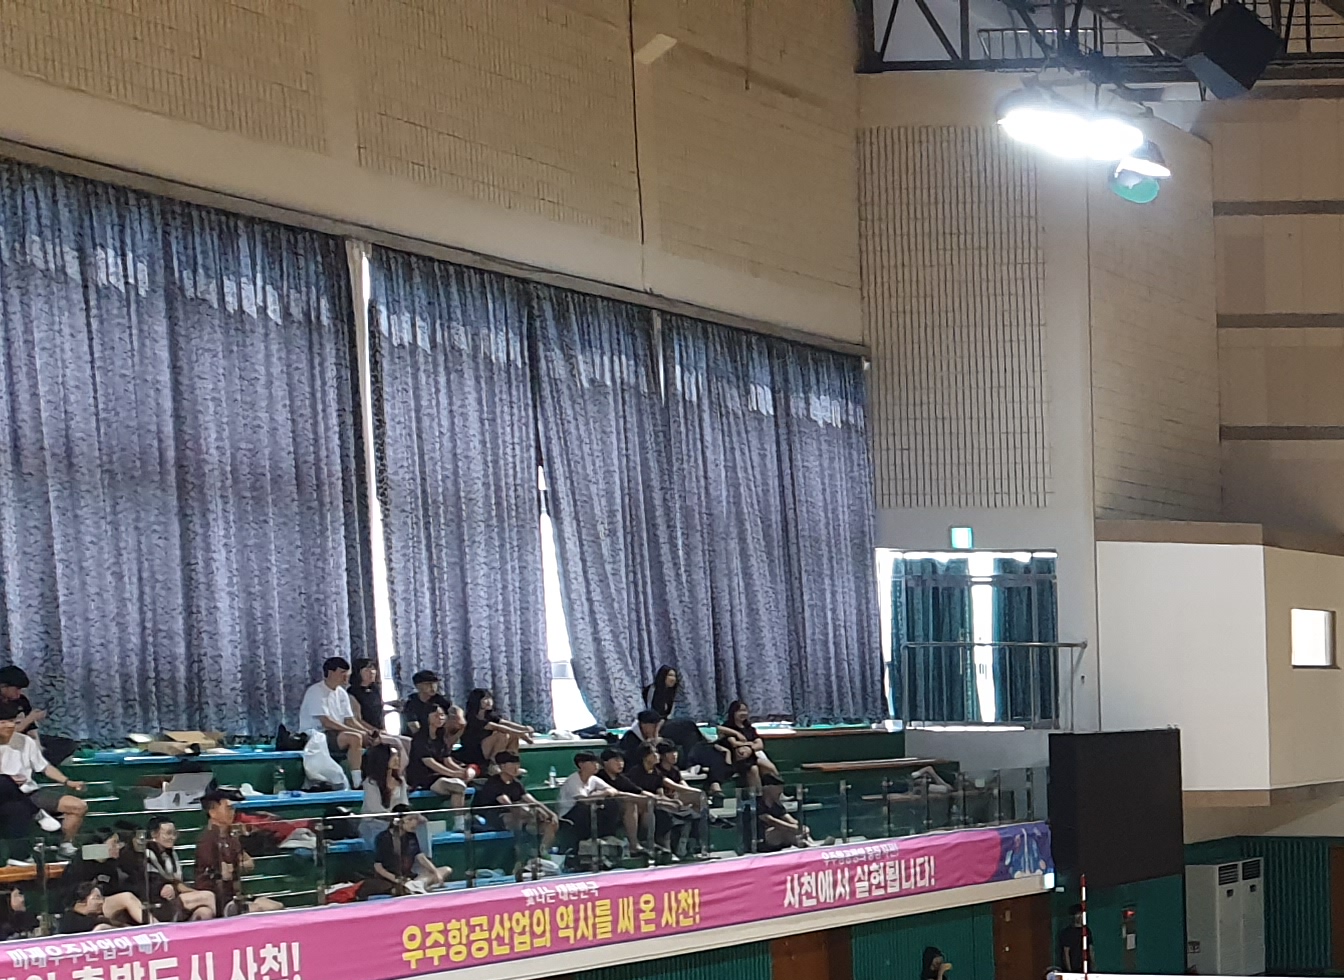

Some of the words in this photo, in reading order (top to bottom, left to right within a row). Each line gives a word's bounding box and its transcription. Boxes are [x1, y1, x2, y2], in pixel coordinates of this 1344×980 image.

[784, 868, 850, 909] 사천에서
[854, 855, 936, 900] 실현됩니다!
[402, 907, 551, 969] 우주항공산업의
[556, 898, 612, 944] 역사를
[618, 897, 634, 935] 써
[639, 893, 656, 933] 온
[661, 888, 701, 928] 사천!
